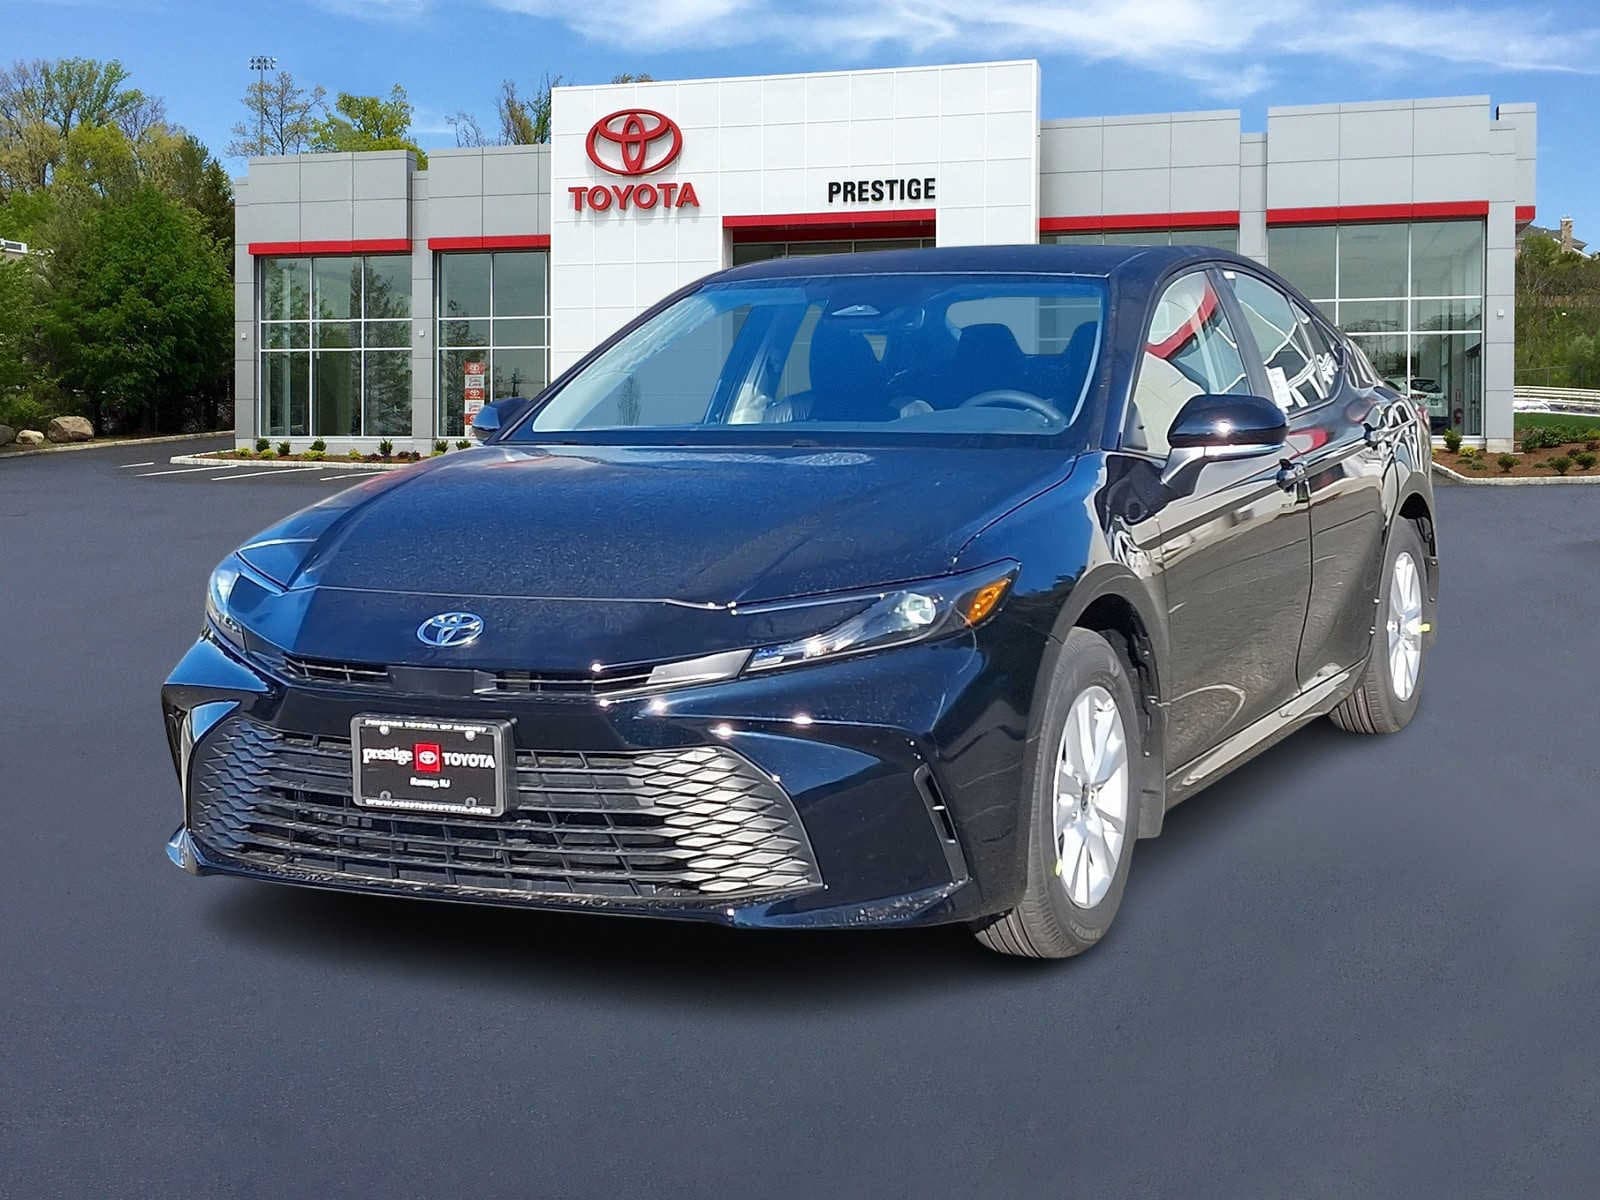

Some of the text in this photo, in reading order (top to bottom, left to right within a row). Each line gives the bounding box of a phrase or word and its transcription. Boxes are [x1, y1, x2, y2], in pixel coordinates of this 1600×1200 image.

[568, 182, 700, 212] TOYOTA
[827, 178, 936, 203] PRESTIGE
[362, 747, 495, 769] prestige TOYOTA
